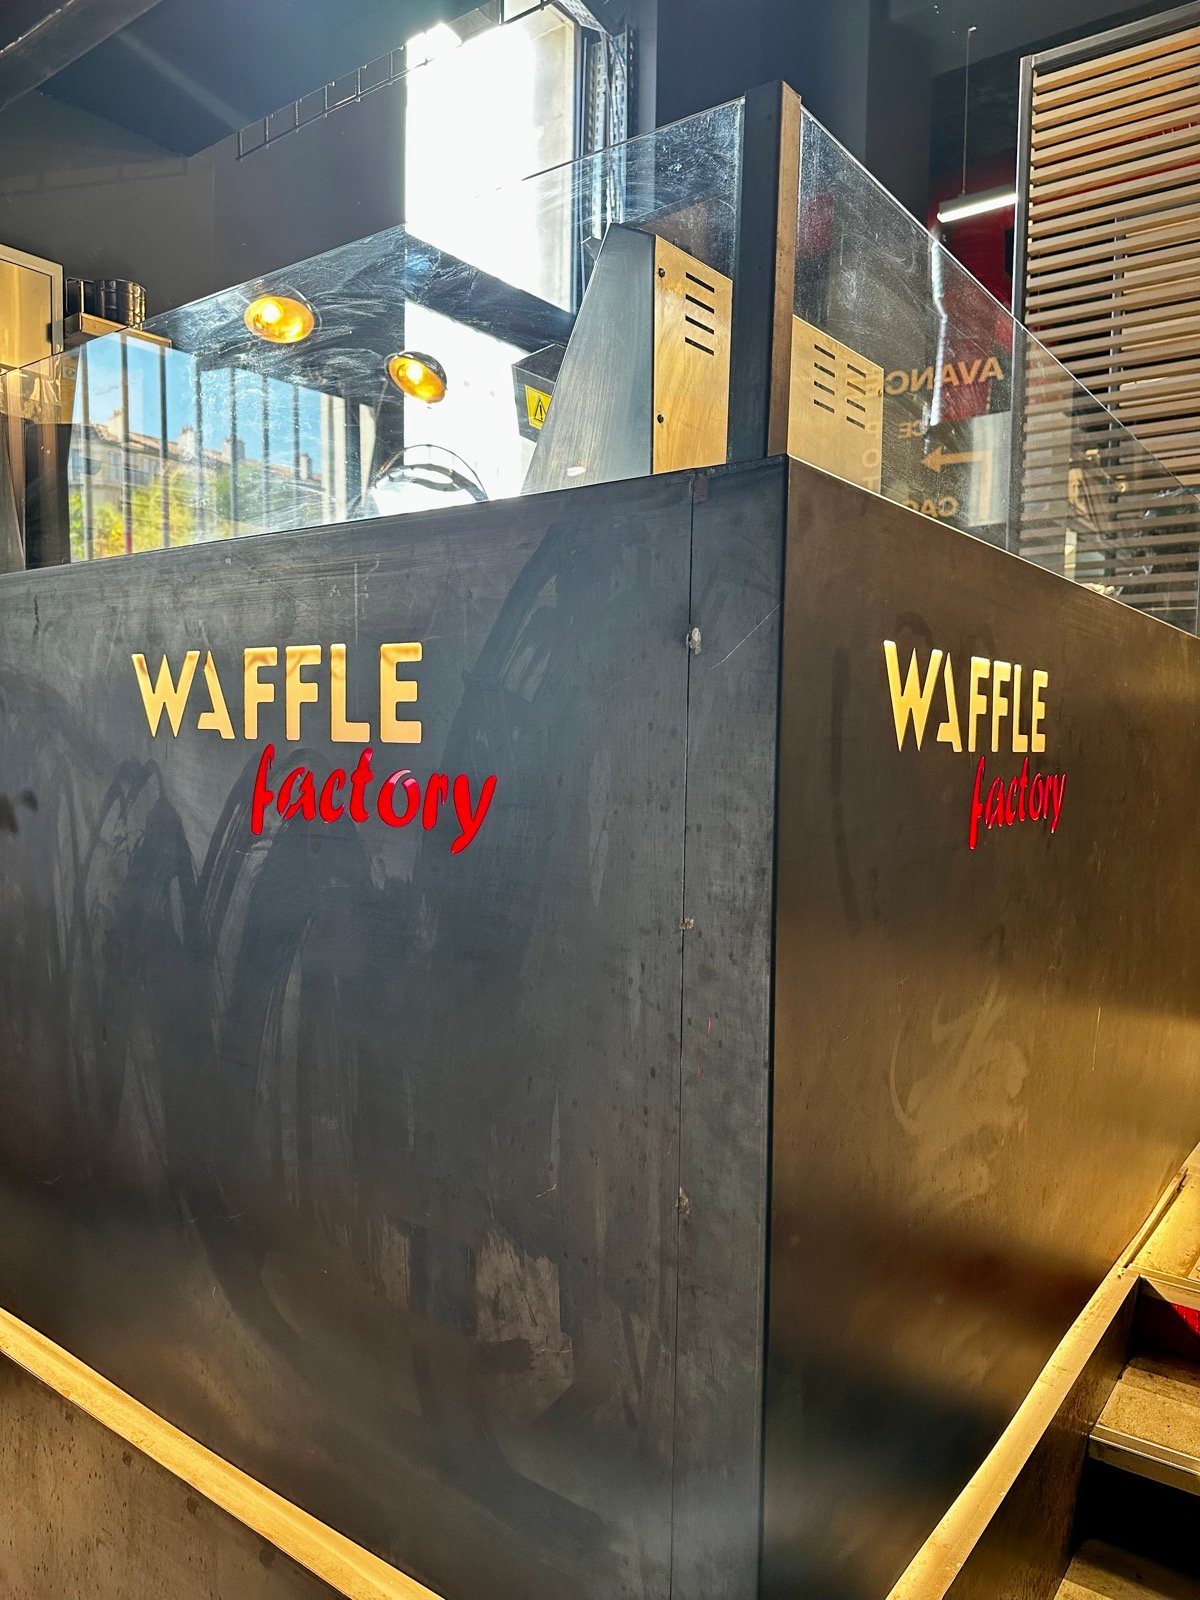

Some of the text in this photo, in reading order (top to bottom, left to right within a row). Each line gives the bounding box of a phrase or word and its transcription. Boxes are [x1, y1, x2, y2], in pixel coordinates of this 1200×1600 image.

[131, 642, 422, 744] WAFFLE
[883, 639, 1049, 753] WAFFLE
[251, 743, 497, 854] factory
[968, 755, 1067, 850] factory
